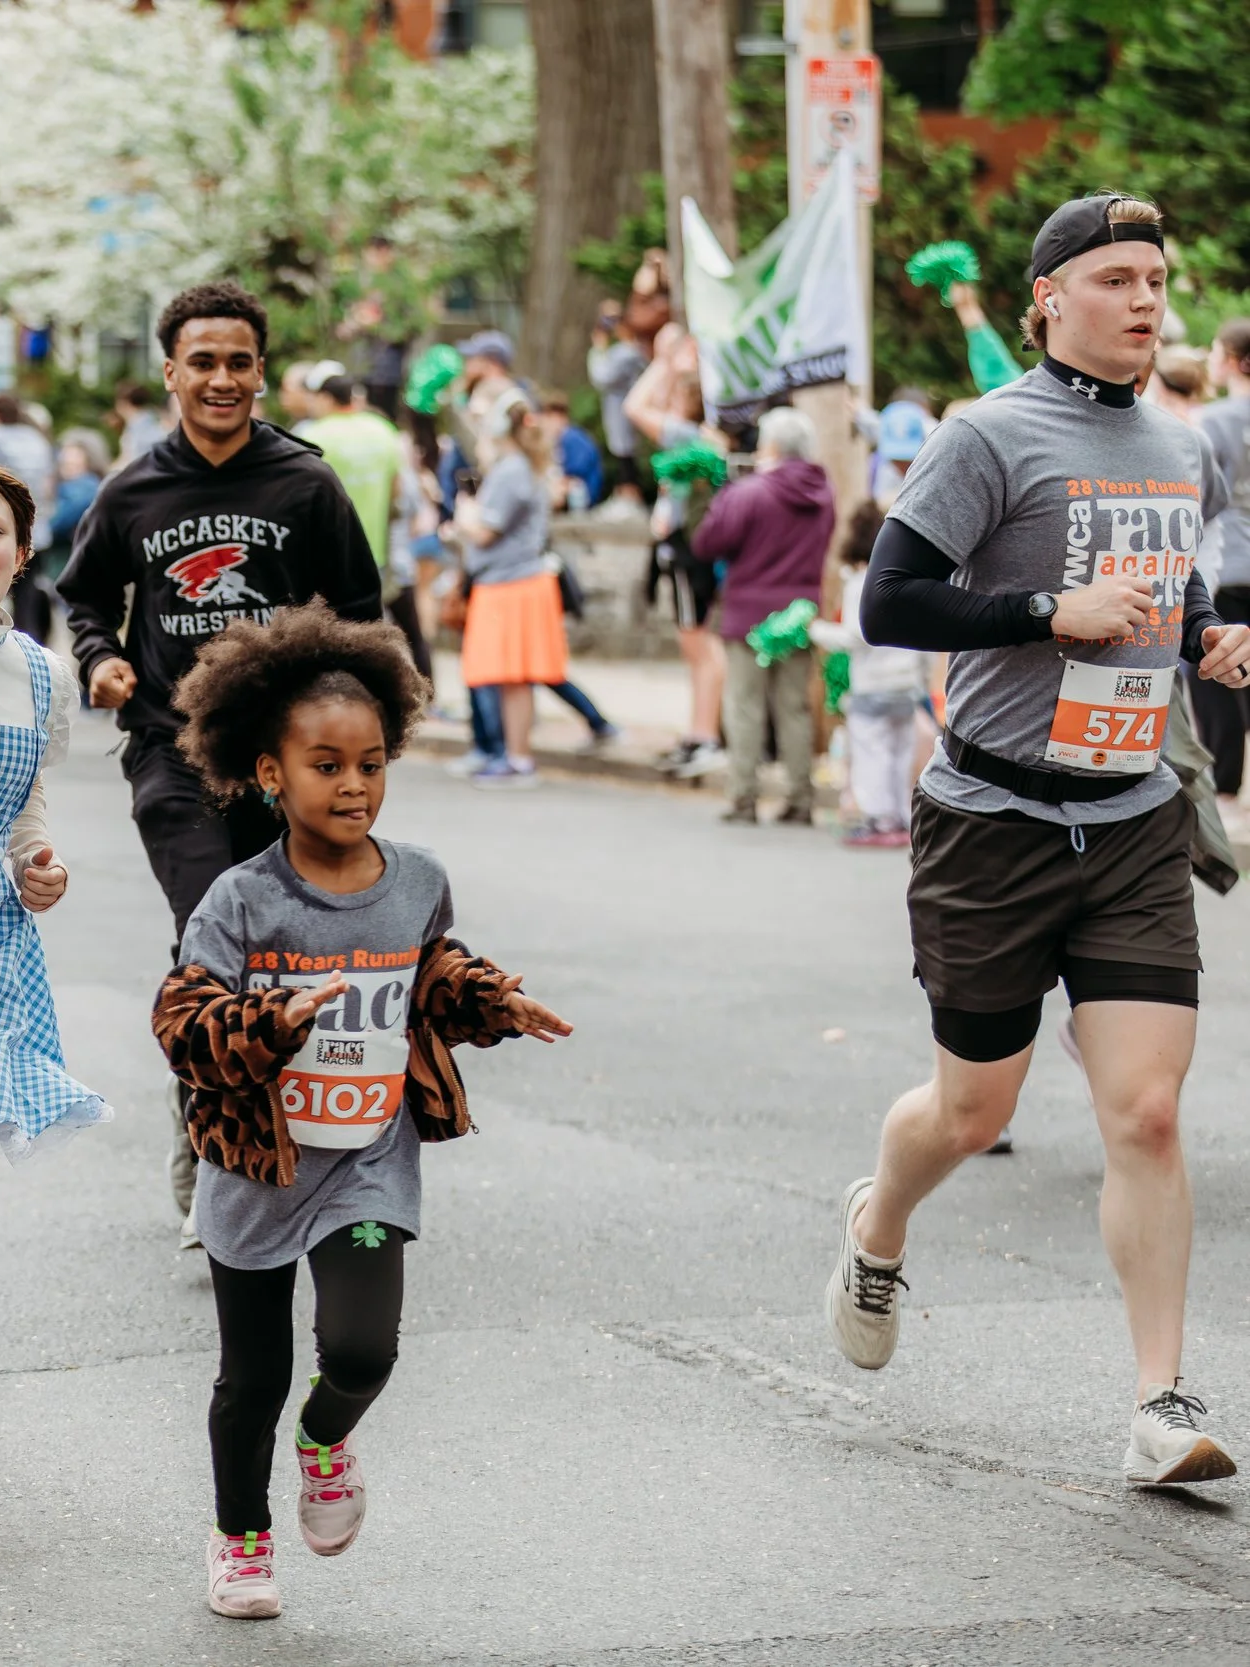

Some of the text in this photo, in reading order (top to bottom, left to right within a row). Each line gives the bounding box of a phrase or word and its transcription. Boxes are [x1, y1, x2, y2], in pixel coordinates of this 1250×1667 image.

[1066, 480, 1092, 496] 28
[1095, 480, 1143, 495] Years
[142, 514, 290, 562] MCCASKEY
[1062, 501, 1091, 594] wca
[1100, 549, 1195, 576] again
[1082, 709, 1156, 746] 574
[248, 951, 278, 970] 28
[283, 951, 347, 971] Years
[325, 1057, 363, 1065] RACISM
[280, 1078, 388, 1119] 6102
